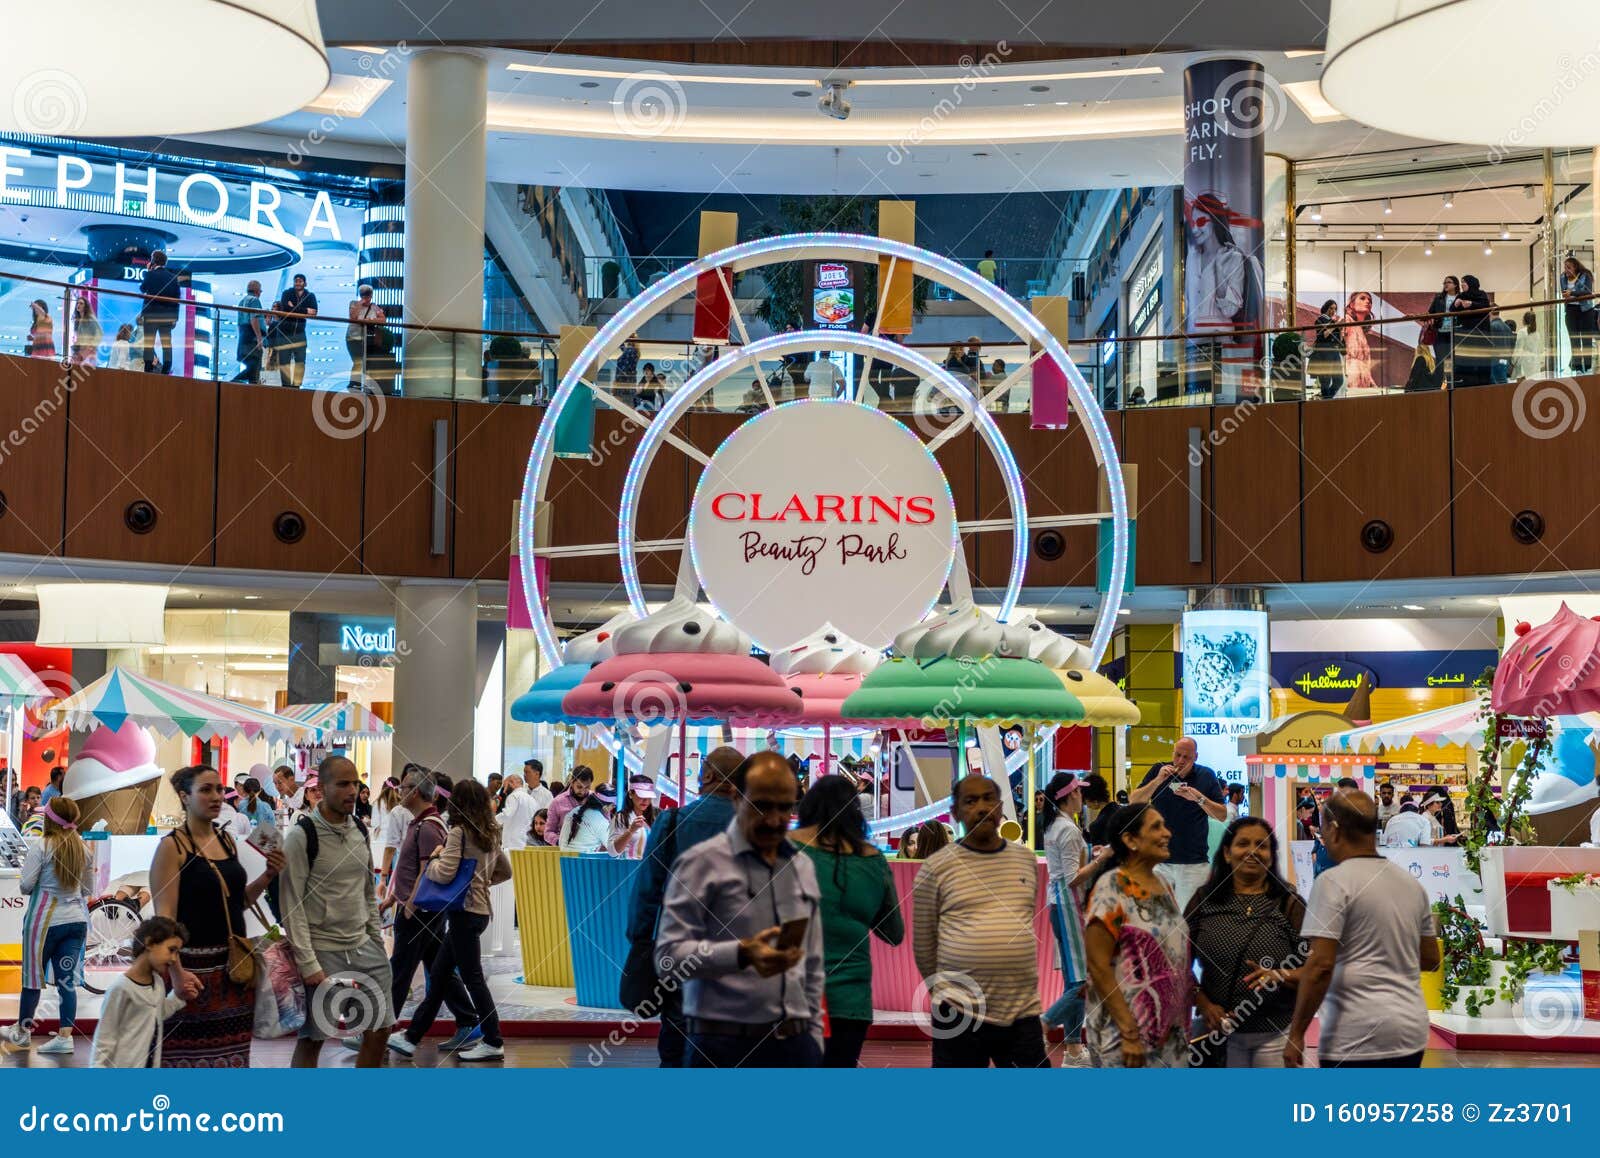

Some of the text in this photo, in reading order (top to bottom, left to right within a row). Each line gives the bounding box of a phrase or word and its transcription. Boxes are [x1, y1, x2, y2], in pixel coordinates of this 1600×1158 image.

[1185, 97, 1235, 121] SHOP.
[1184, 120, 1236, 144] EARN.
[1191, 143, 1222, 162] FLY.
[711, 492, 935, 524] CLARINS
[739, 531, 907, 575] Beauty Park
[1209, 723, 1219, 734] &
[1220, 724, 1228, 734] A
[1501, 723, 1544, 734] CLARINS
[1226, 770, 1243, 780] GET
